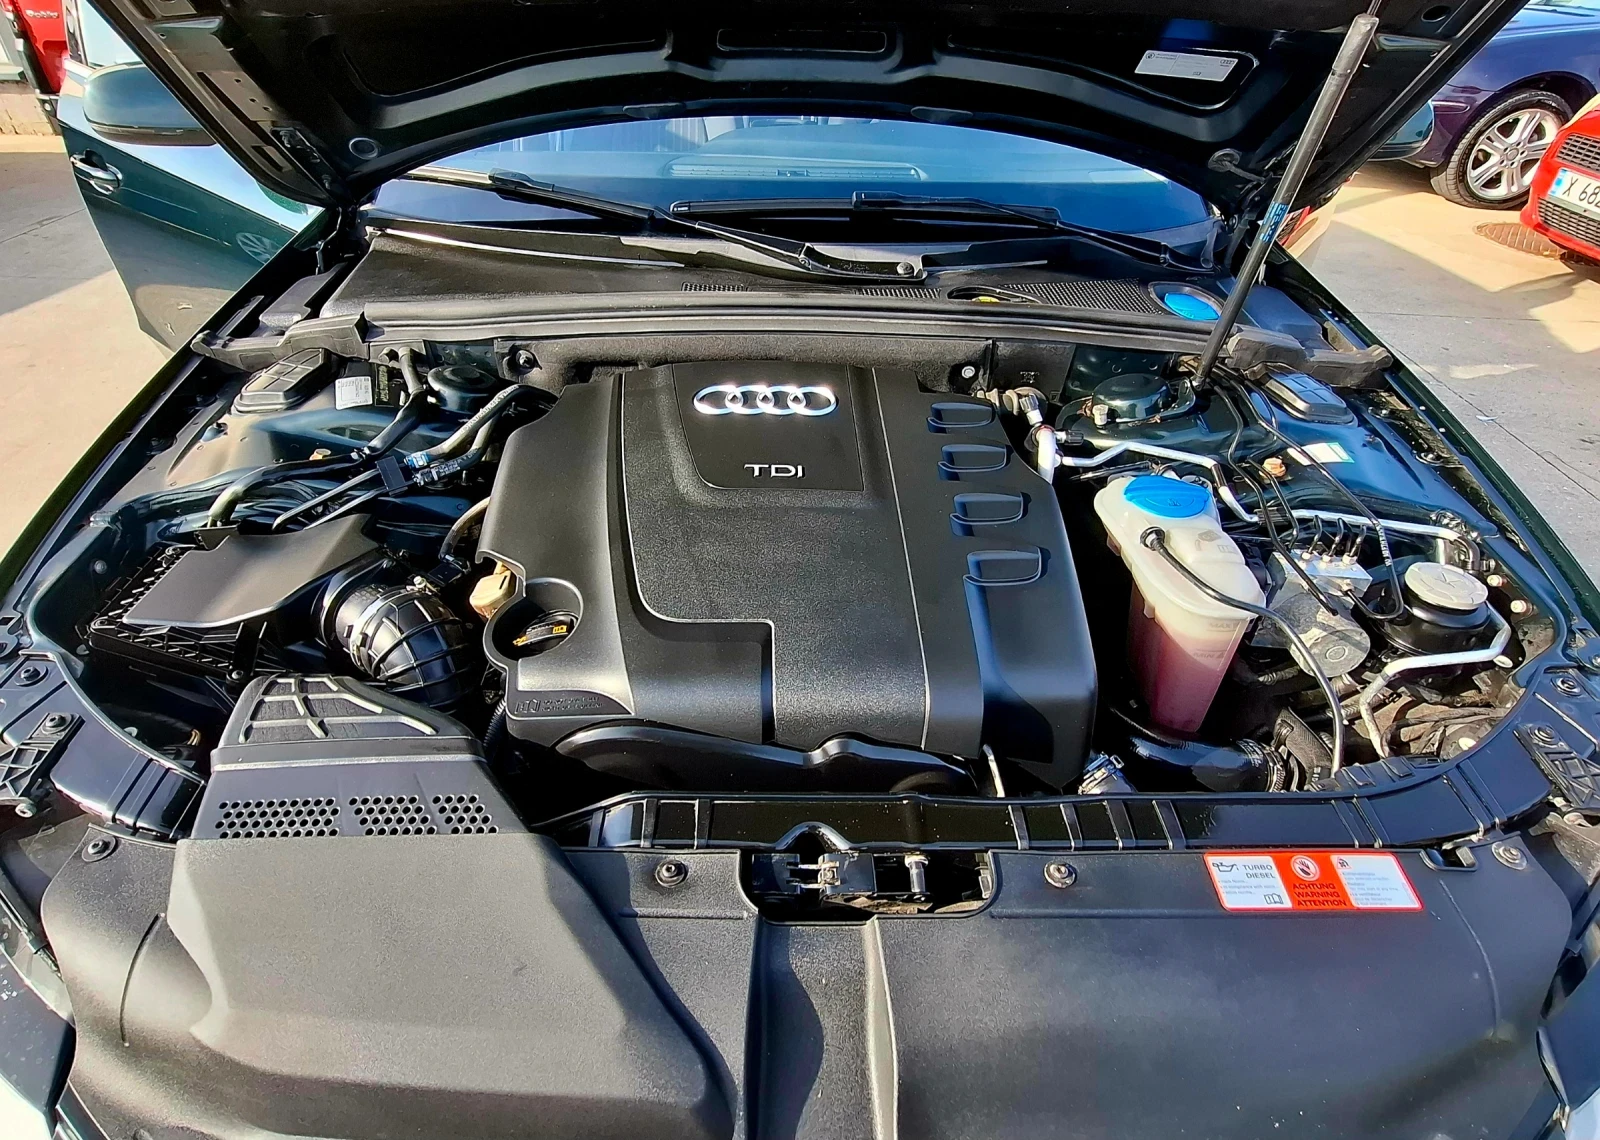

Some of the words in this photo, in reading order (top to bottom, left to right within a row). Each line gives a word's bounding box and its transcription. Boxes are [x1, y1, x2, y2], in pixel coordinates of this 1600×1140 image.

[1562, 176, 1579, 197] X
[744, 464, 803, 478] TDI
[1292, 882, 1336, 890] ACHTUNG
[1297, 899, 1347, 907] ATTENTION
